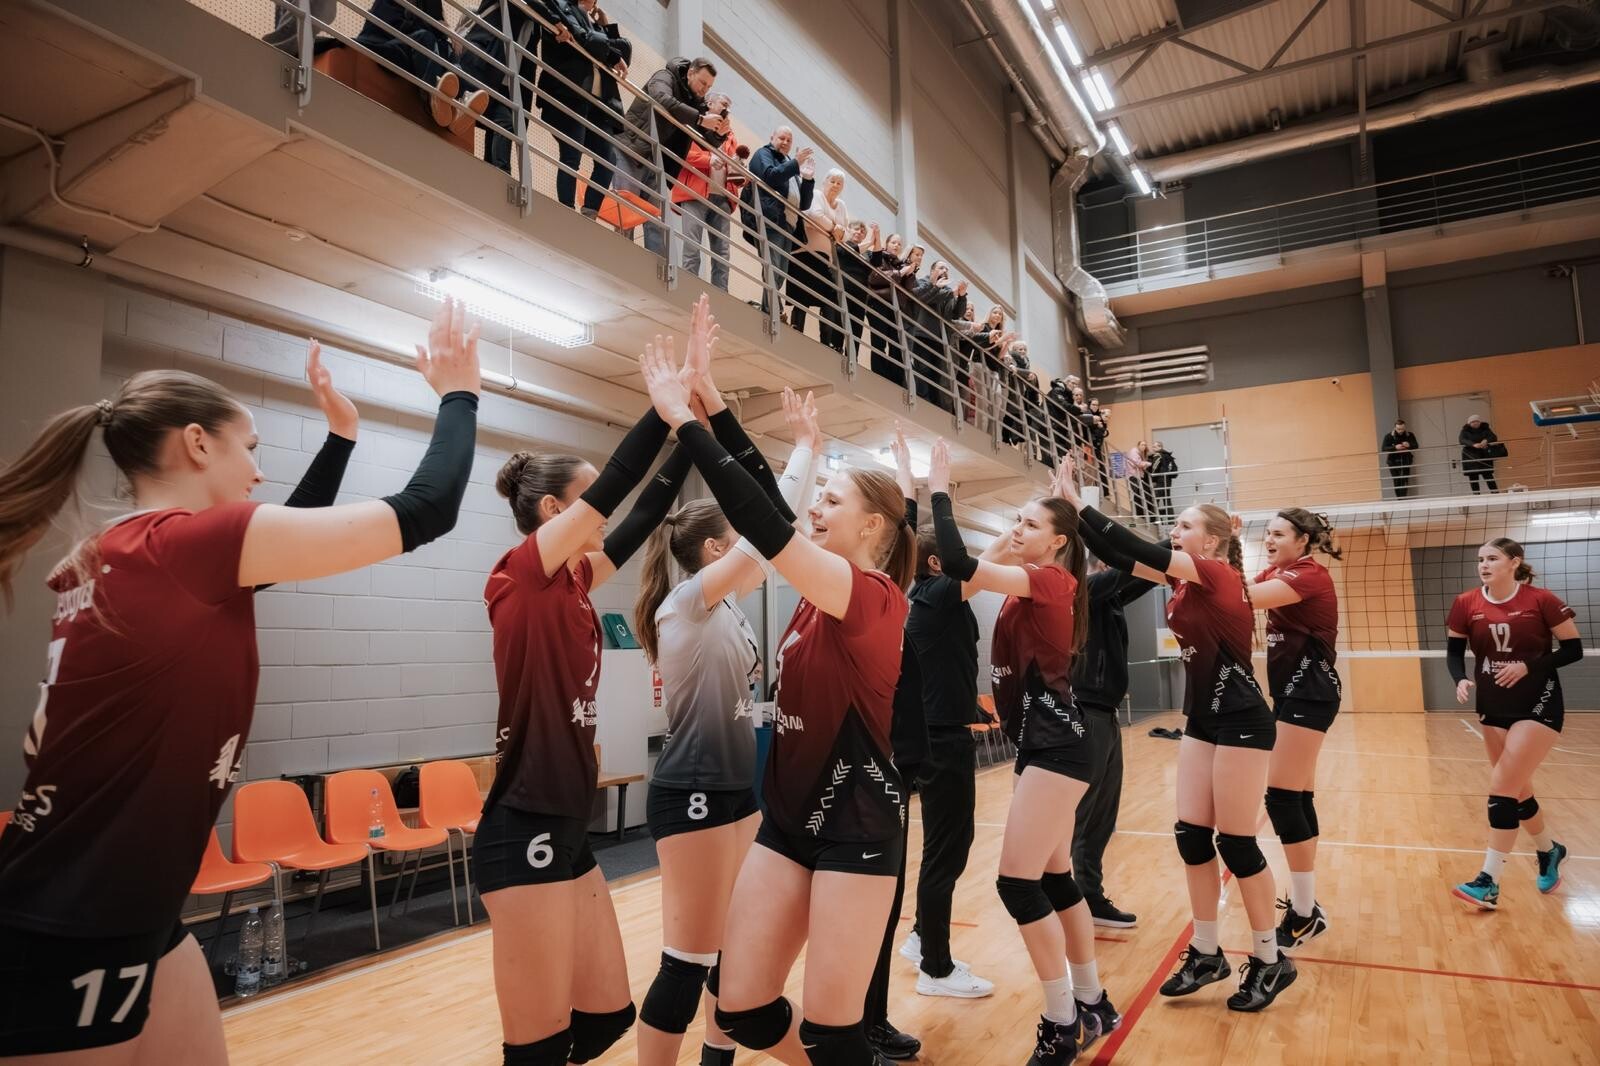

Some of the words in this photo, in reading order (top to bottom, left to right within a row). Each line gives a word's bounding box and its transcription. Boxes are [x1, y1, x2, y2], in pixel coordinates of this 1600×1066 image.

[1488, 622, 1512, 652] 12
[687, 792, 709, 820] 8
[526, 832, 554, 869] 6
[71, 963, 148, 1027] 17
